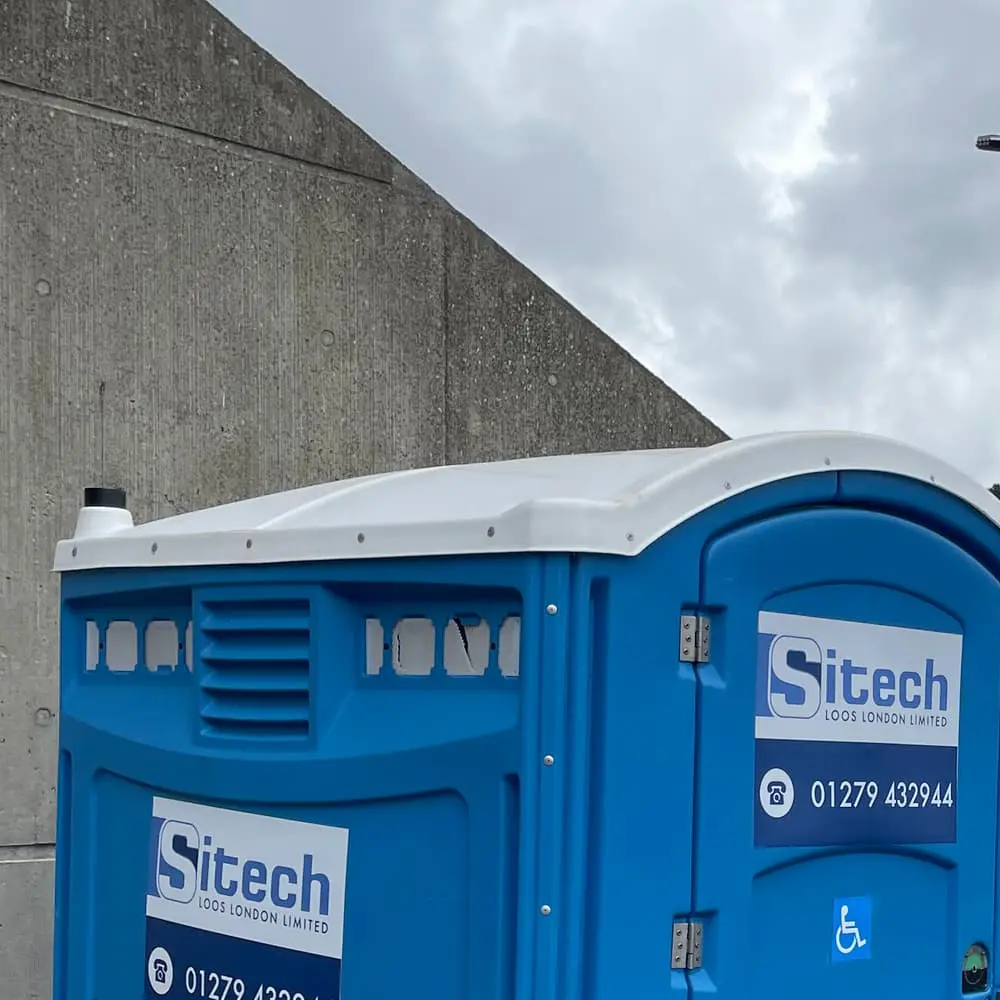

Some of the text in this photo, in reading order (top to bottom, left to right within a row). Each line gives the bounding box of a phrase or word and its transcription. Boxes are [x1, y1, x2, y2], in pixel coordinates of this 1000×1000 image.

[770, 635, 948, 719] Sitech
[825, 709, 948, 727] LOOS LONDON LIMITED
[811, 781, 953, 808] 01279 432944
[157, 819, 330, 916] Sitech
[199, 897, 329, 934] LOOS LONDON LIMITED
